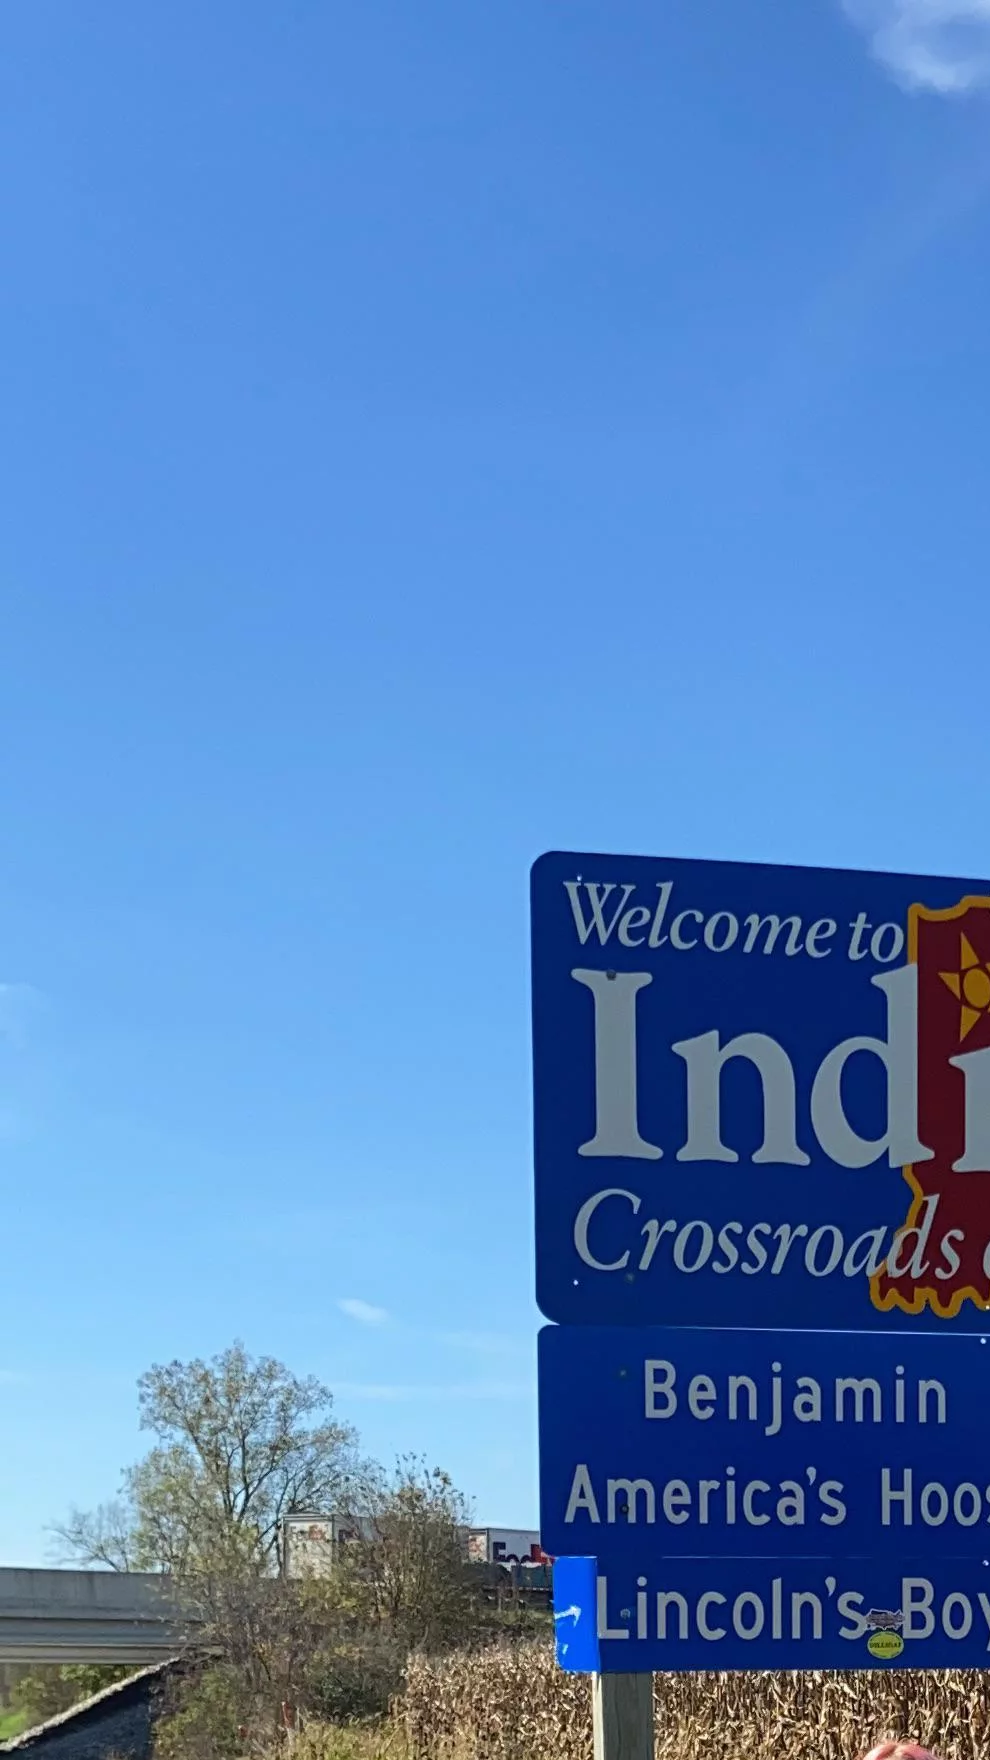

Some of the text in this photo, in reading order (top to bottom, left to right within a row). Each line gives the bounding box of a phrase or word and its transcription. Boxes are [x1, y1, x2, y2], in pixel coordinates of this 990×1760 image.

[562, 881, 904, 963] Welcome to
[574, 1188, 965, 1280] Crossroads
[644, 1359, 946, 1436] Benjamin
[564, 1464, 847, 1526] America's
[596, 1576, 866, 1640] Lincoln's
